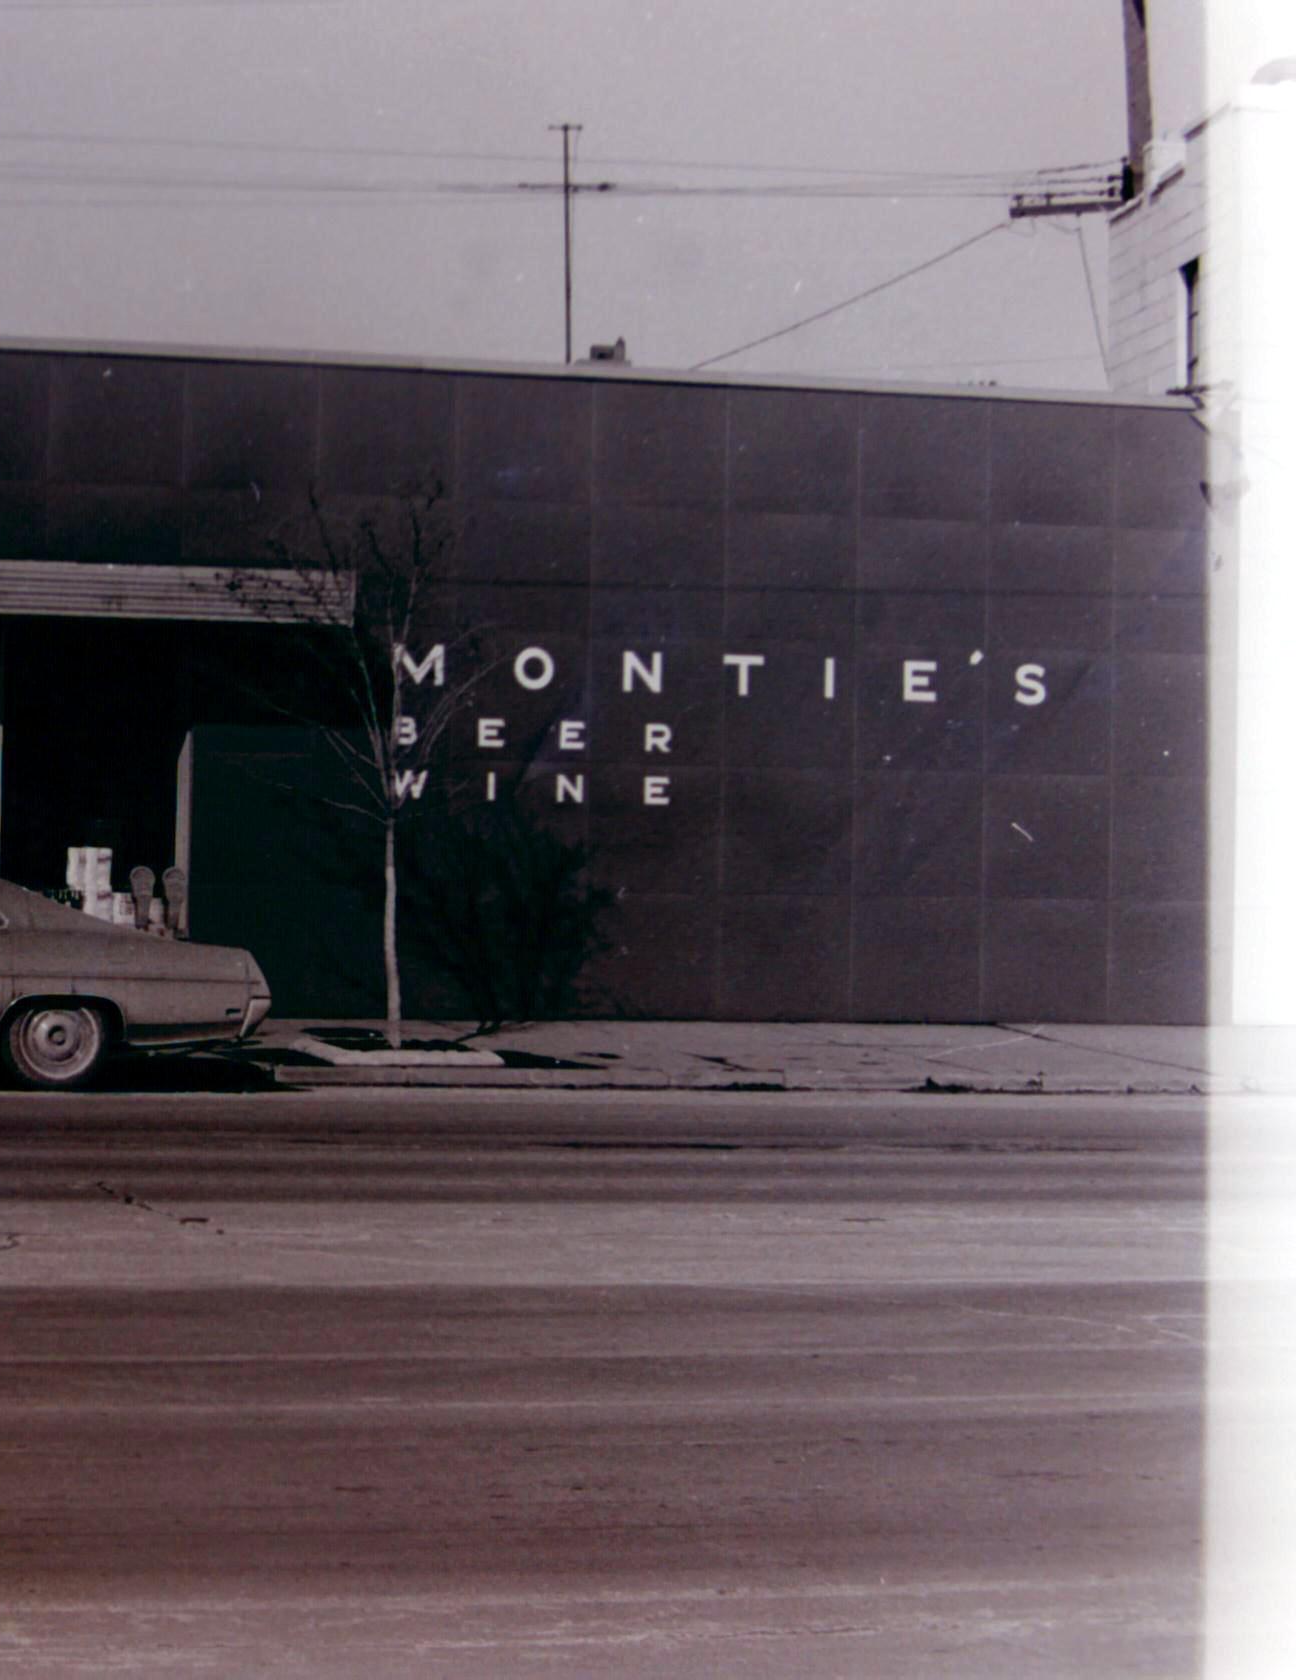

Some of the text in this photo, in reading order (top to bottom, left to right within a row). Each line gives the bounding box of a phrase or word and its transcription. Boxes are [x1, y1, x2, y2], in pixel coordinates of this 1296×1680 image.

[392, 642, 1047, 706] MONTIE'S
[396, 714, 674, 755] BEER
[392, 768, 672, 807] WINE
